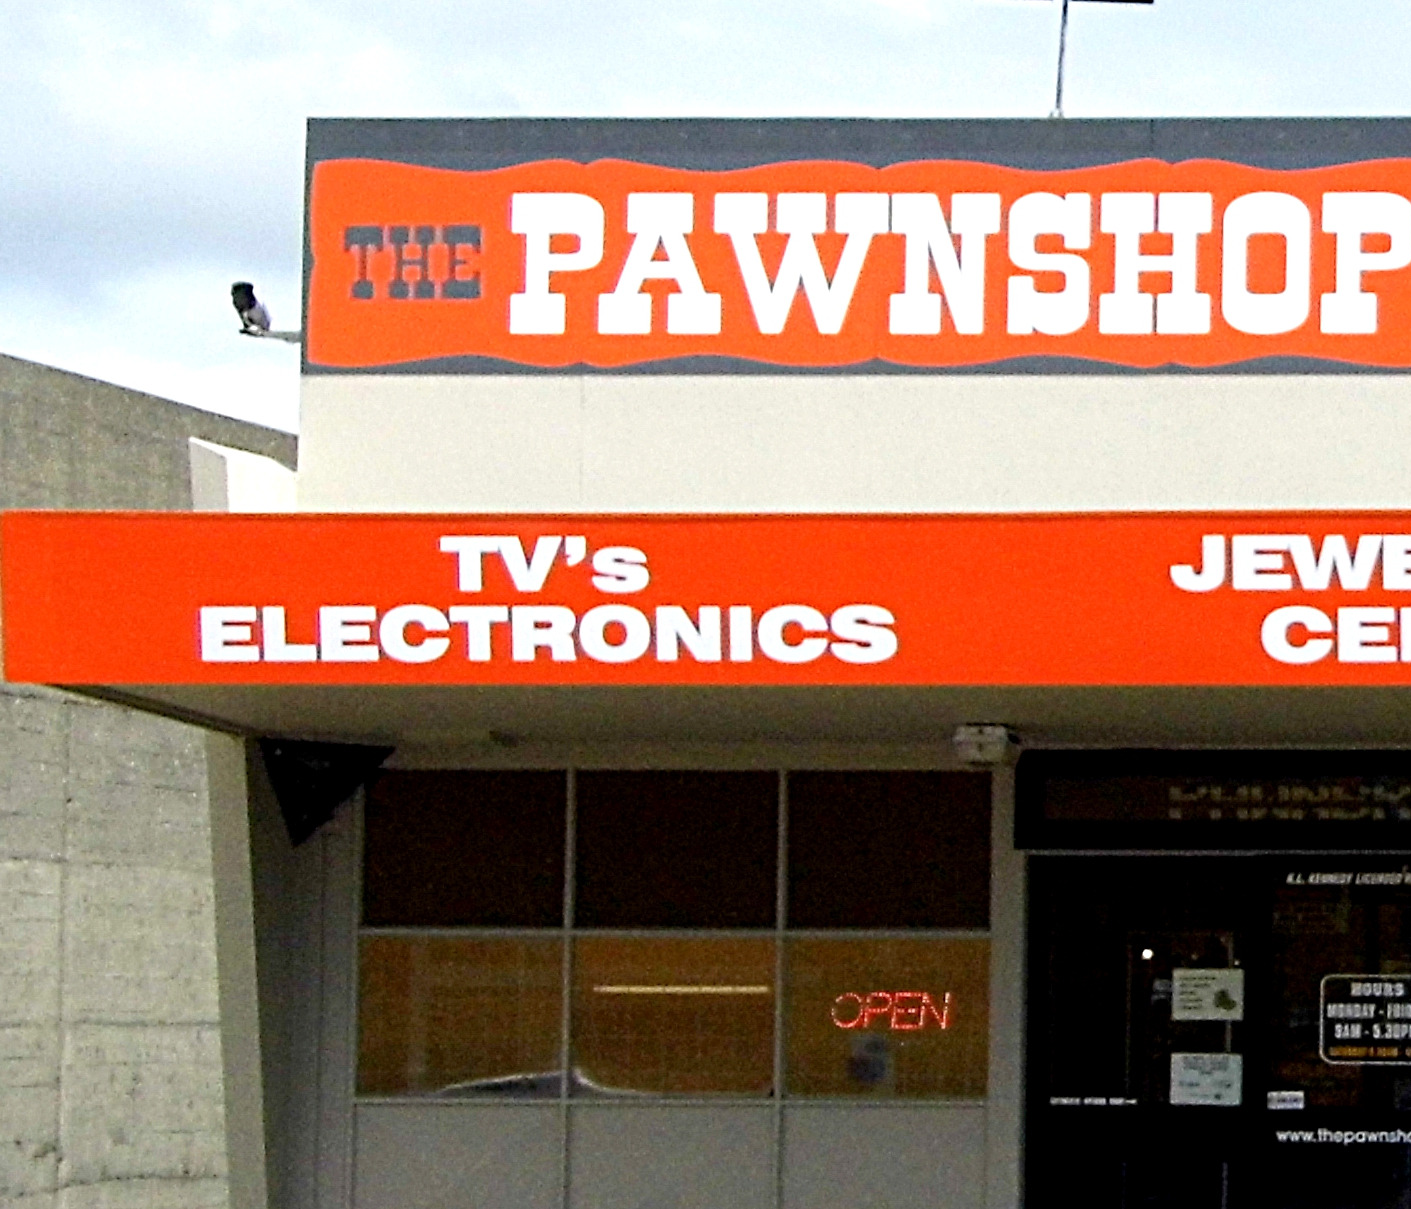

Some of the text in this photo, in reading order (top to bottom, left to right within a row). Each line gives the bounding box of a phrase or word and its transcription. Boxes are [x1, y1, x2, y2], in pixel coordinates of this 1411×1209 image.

[344, 225, 482, 299] THE
[440, 535, 650, 593] TV's
[199, 604, 898, 664] ELECTRONICS
[831, 991, 952, 1030] OPEN
[1326, 1003, 1376, 1019] MONDAY
[1350, 981, 1405, 997] HOURS
